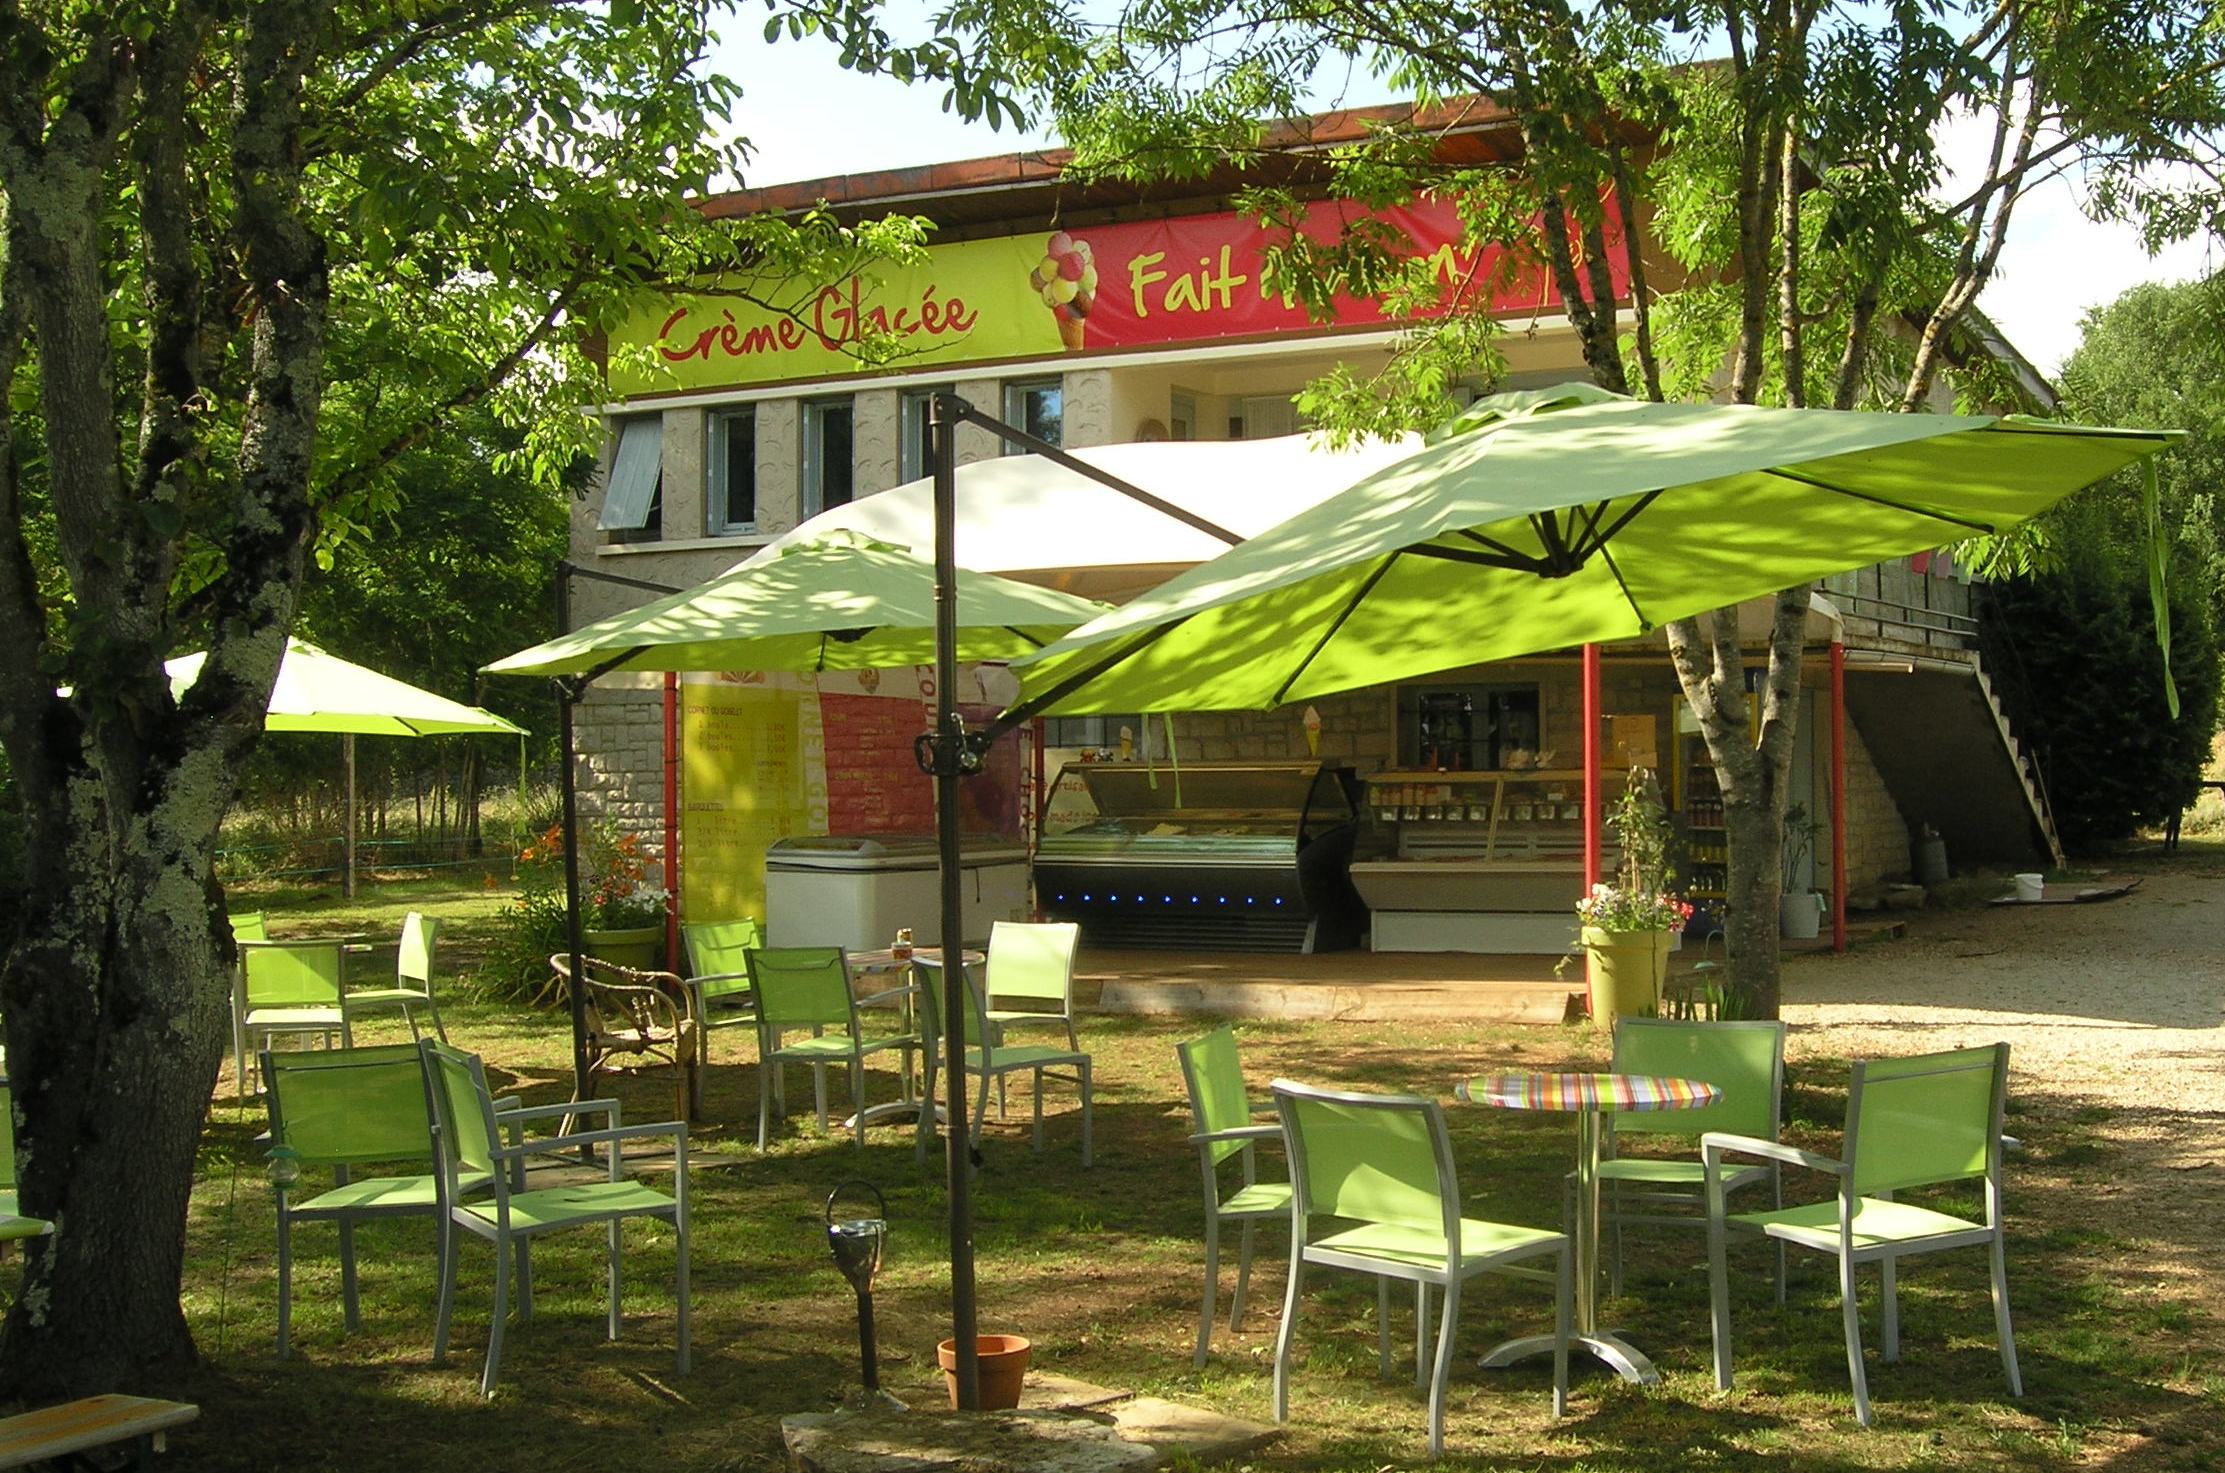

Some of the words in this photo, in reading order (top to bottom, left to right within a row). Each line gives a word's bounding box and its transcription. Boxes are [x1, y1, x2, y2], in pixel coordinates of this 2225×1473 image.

[659, 306, 806, 362] Crème
[814, 274, 979, 352] Glacée
[1127, 243, 1248, 318] Fait
